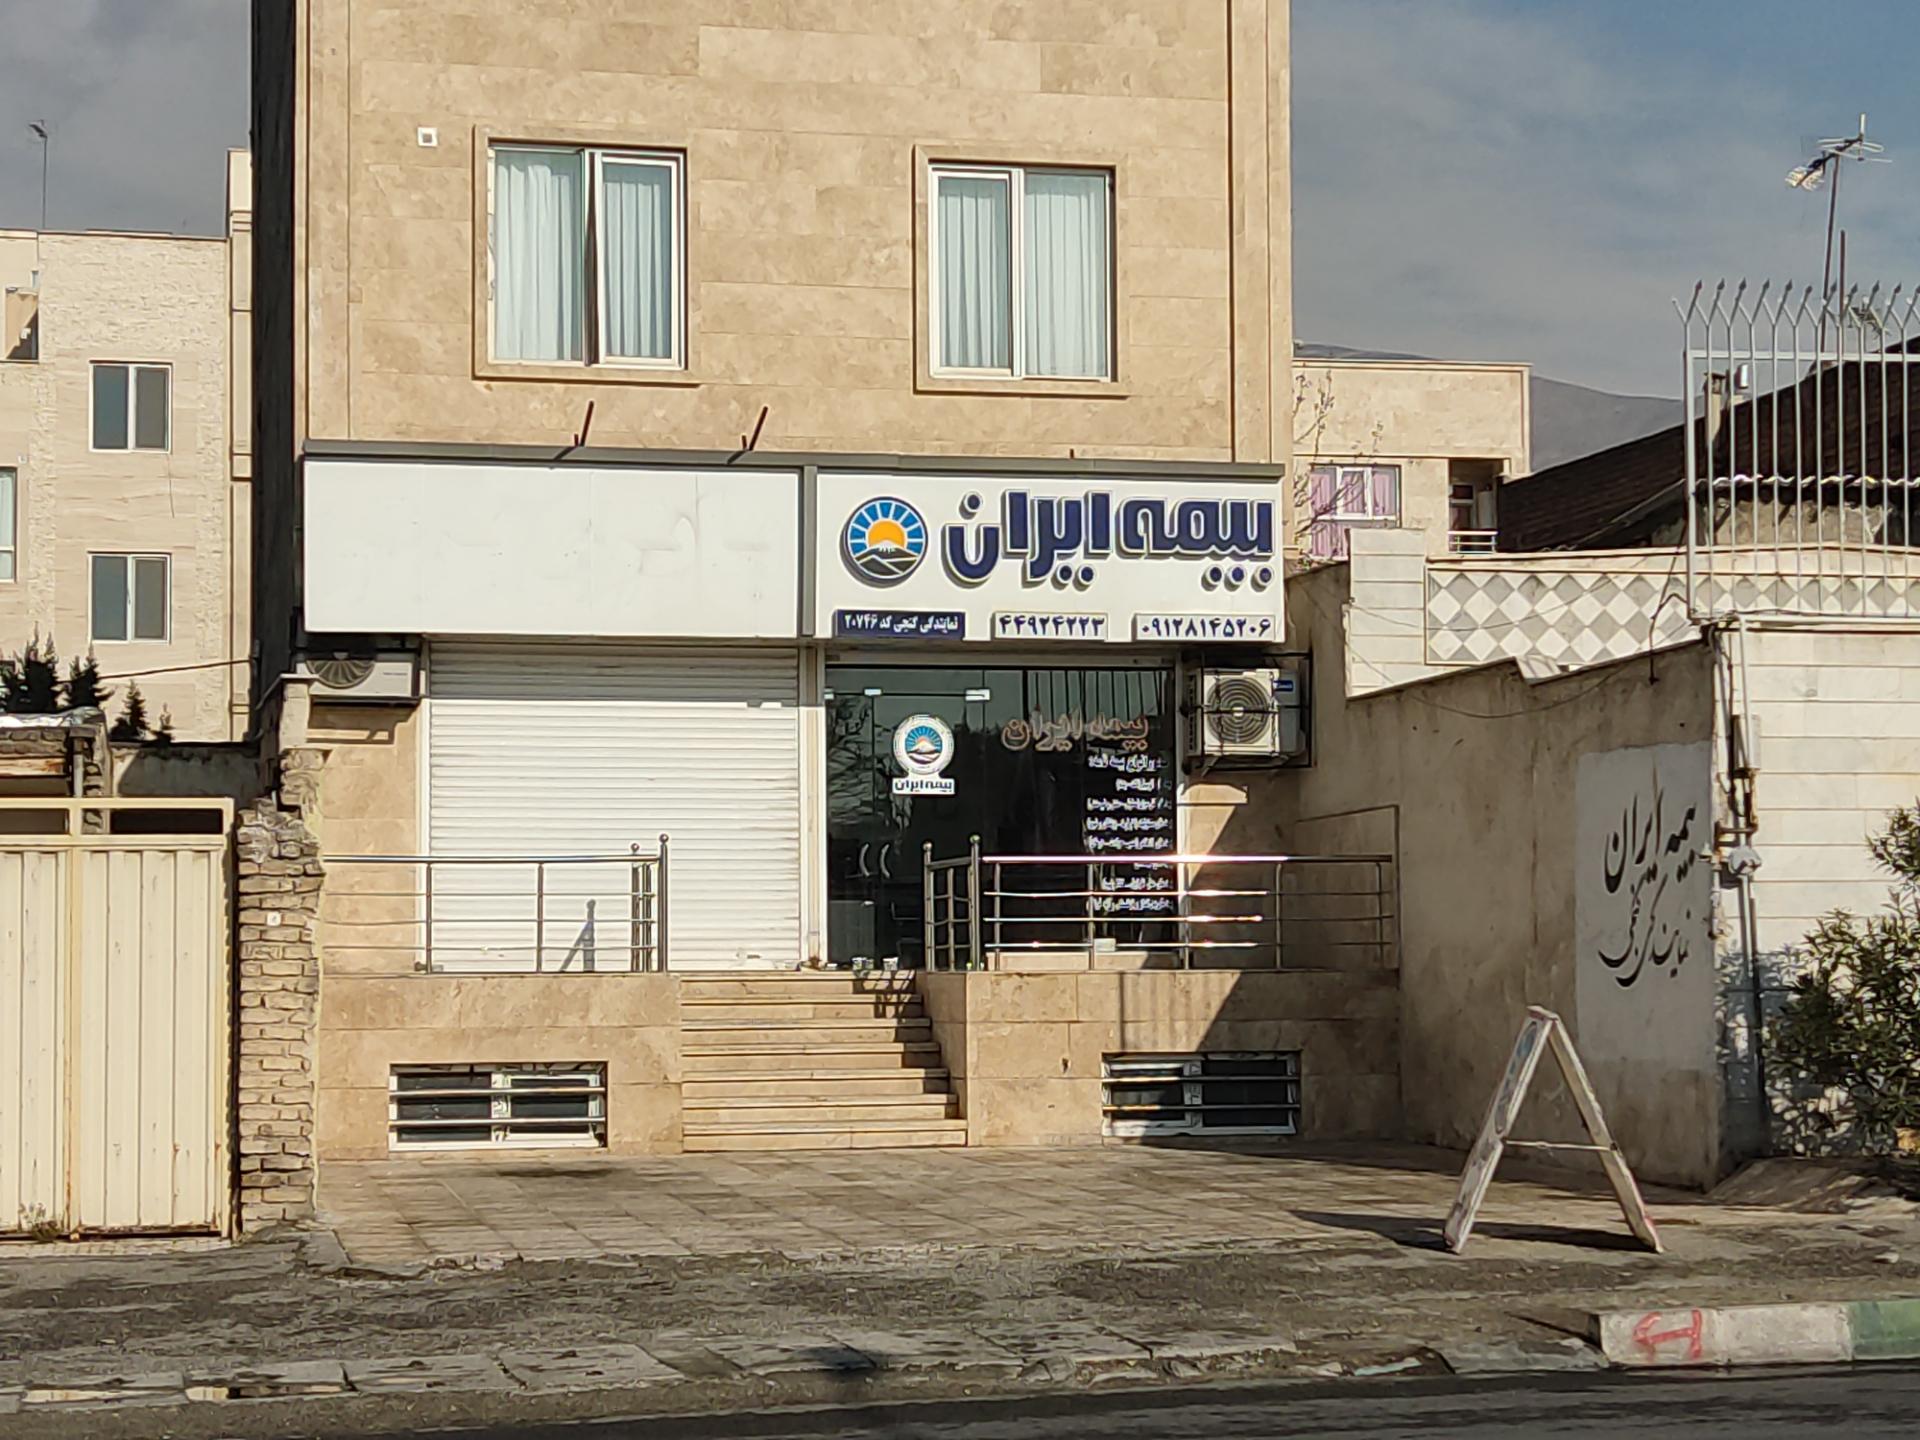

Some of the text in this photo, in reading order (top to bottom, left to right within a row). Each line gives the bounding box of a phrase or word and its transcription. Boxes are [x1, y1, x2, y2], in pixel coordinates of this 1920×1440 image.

[944, 490, 1274, 586] بیمه ایران
[879, 615, 893, 630] کد
[1001, 707, 1150, 751] بیمه ایران
[894, 779, 953, 793] بیمه ایران
[1603, 787, 1698, 895] بیمه ایران
